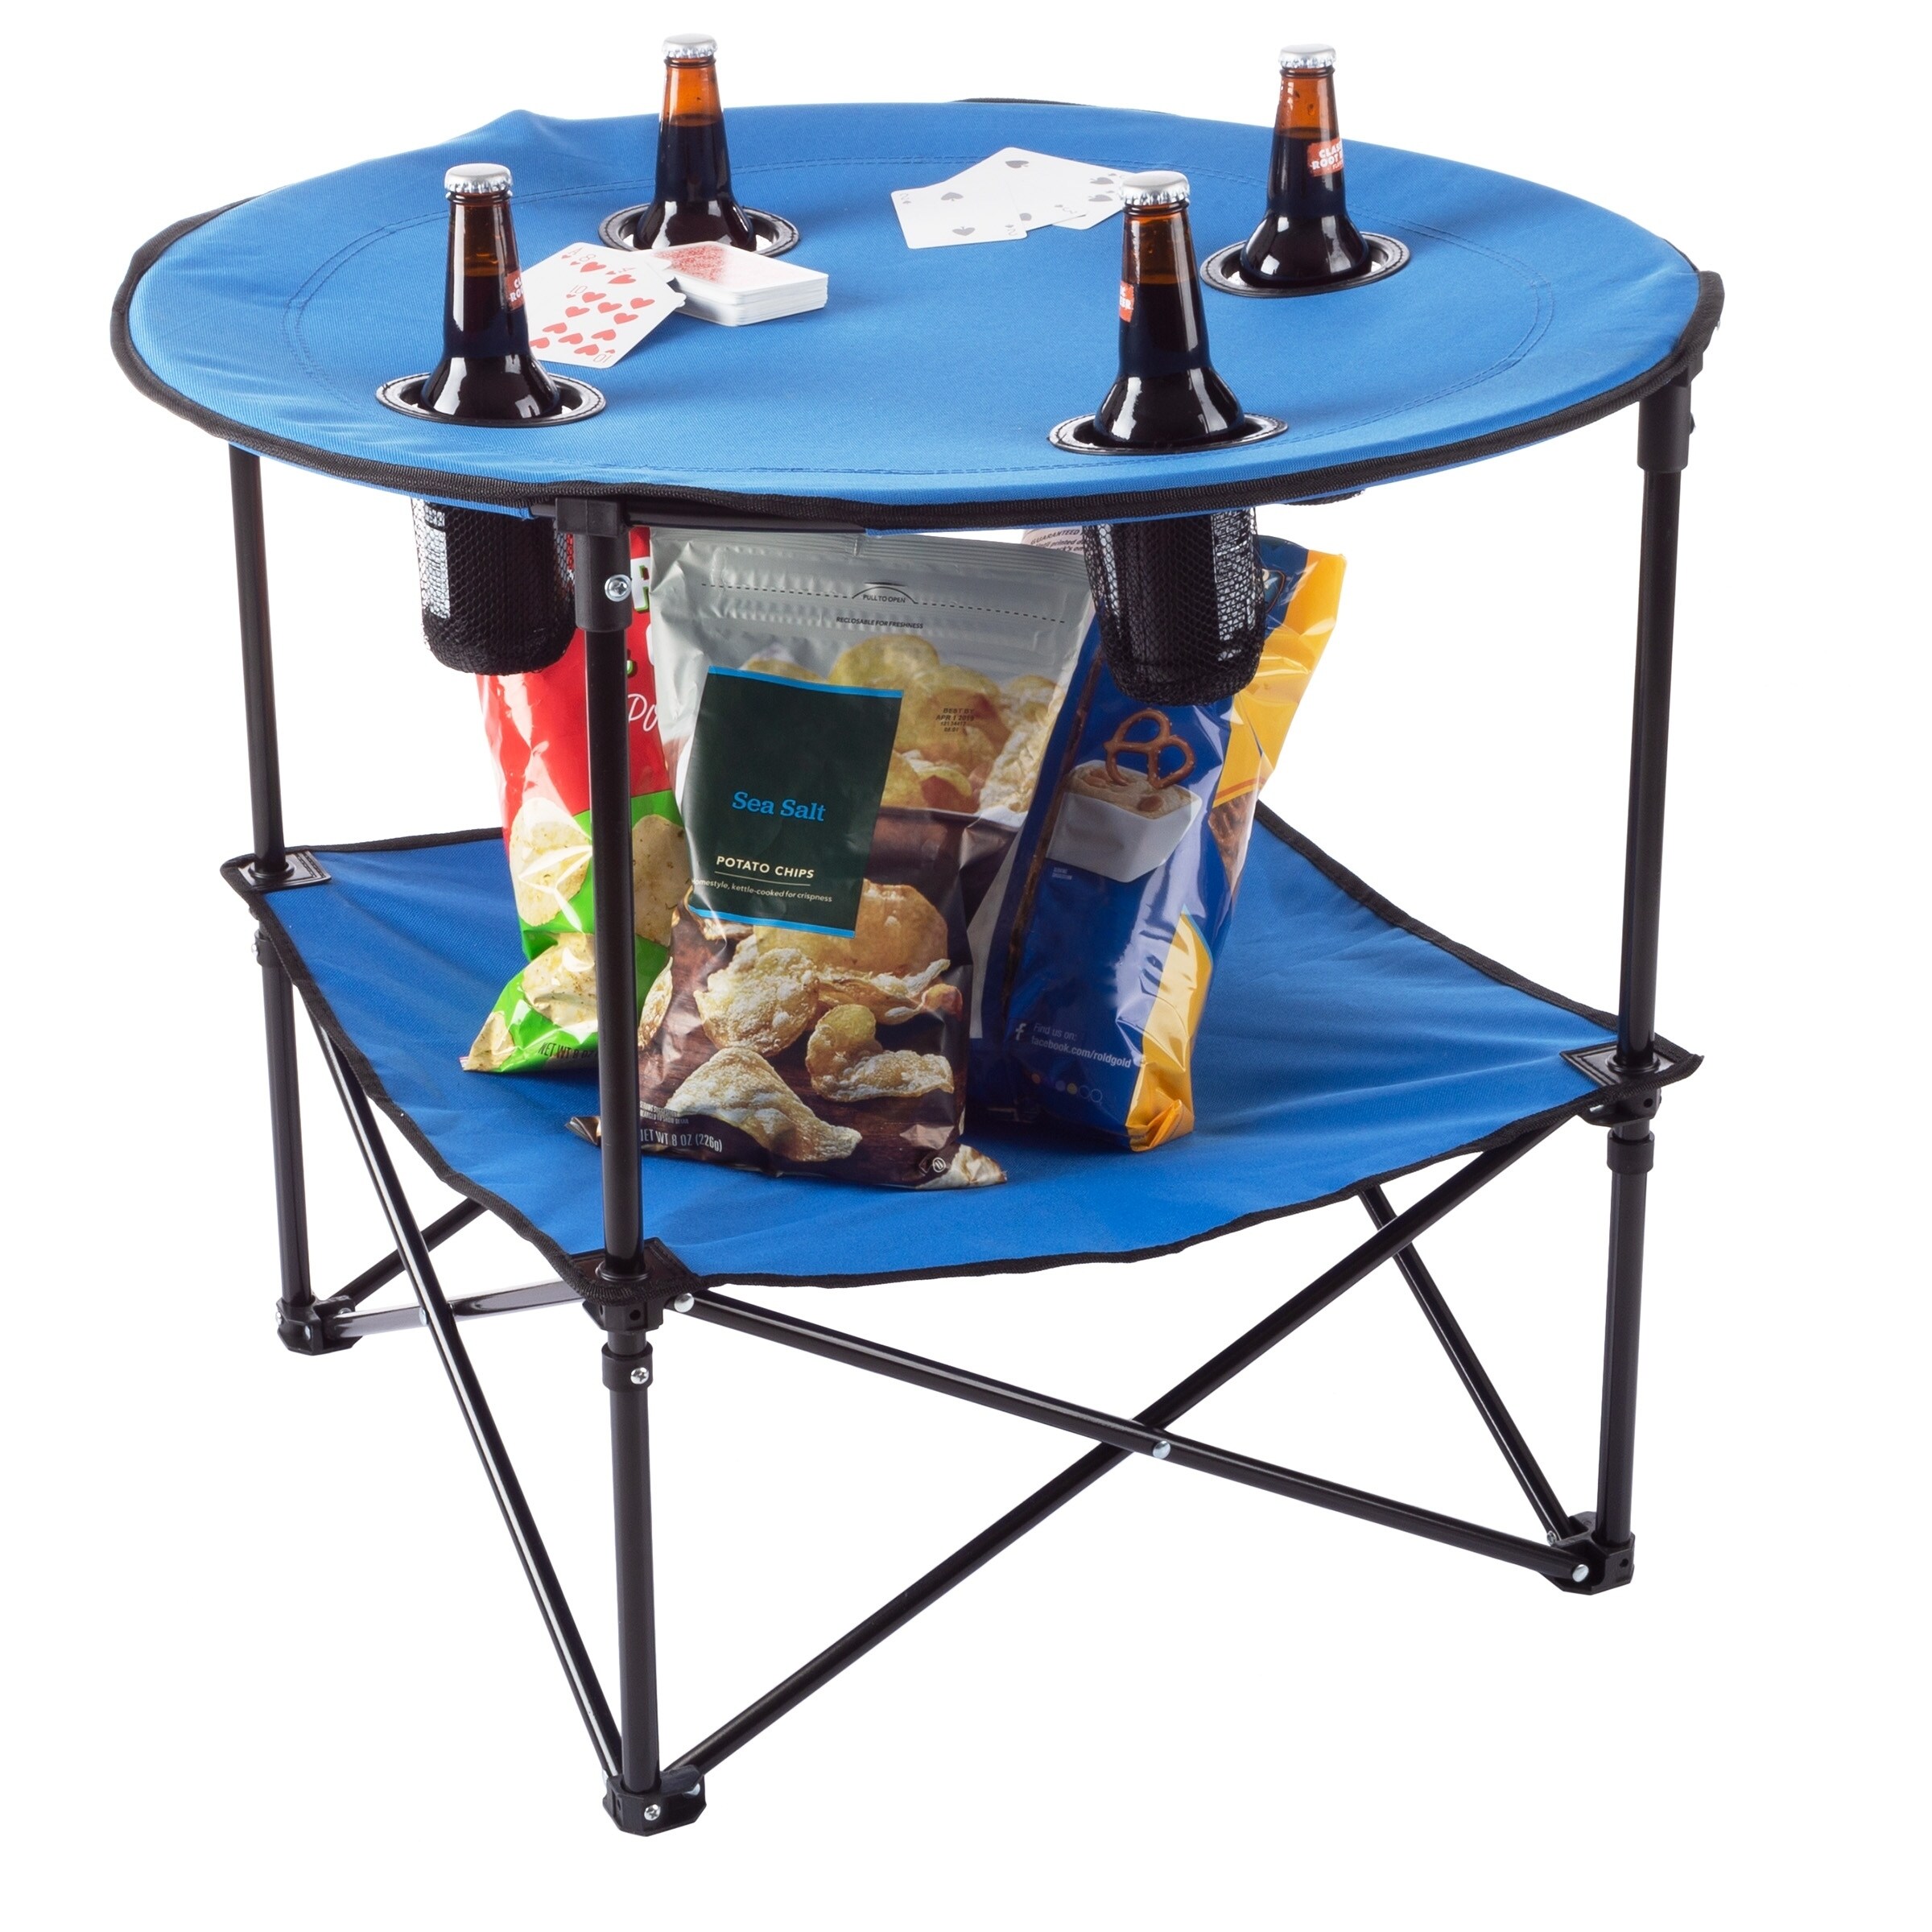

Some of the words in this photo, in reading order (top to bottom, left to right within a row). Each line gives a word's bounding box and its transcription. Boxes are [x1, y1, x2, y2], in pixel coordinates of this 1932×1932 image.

[1030, 529, 1080, 544] GUARANTEED
[836, 617, 875, 625] RECLOSABLE
[732, 791, 774, 815] Sea
[780, 799, 826, 822] Salt
[716, 856, 770, 873] POTATO
[774, 866, 815, 879] CHIPS
[731, 881, 786, 898] kettle-cooked
[785, 890, 797, 898] for
[797, 893, 832, 903] crispness
[1033, 1023, 1051, 1035] Find
[1051, 1029, 1063, 1037] us
[1063, 1031, 1078, 1041] on:
[539, 1042, 557, 1057] NET
[1031, 1035, 1132, 1068] facebook.com/roldgold
[655, 1131, 668, 1145] WT
[671, 1134, 677, 1146] 8
[680, 1134, 692, 1146] OZ
